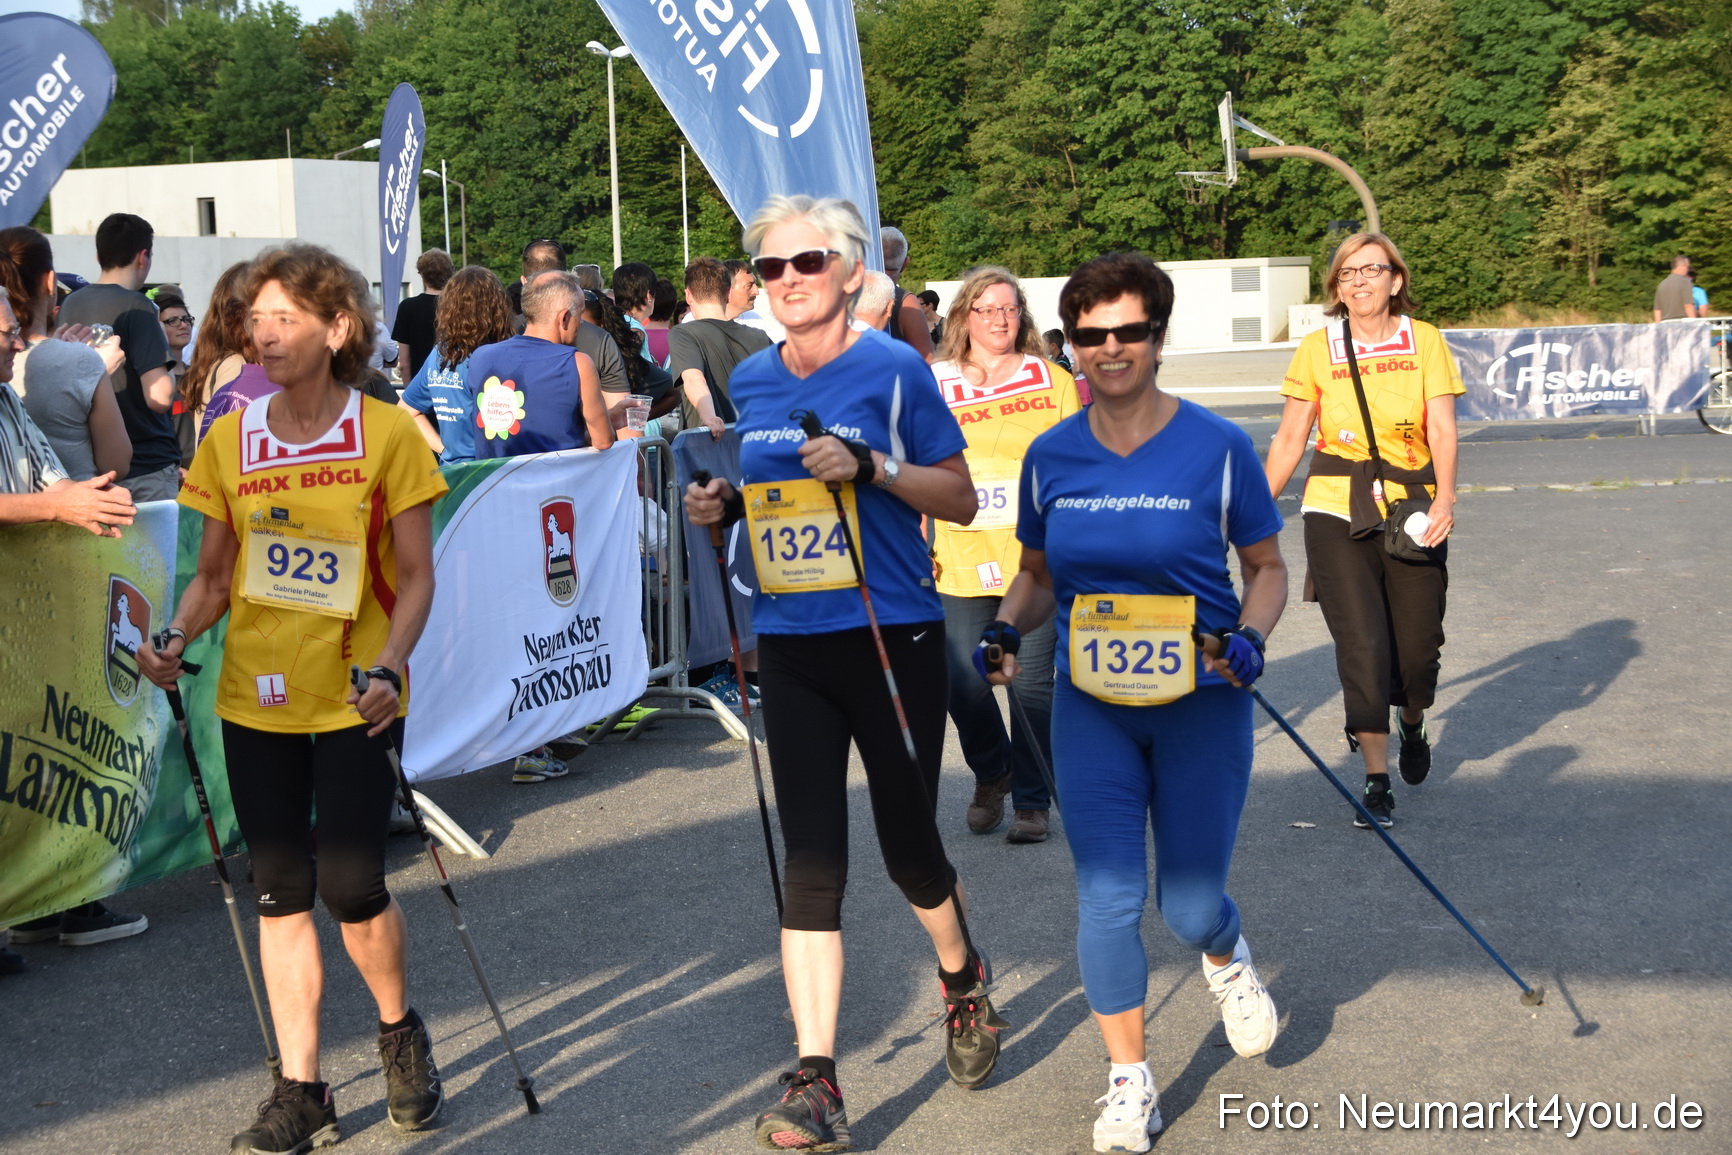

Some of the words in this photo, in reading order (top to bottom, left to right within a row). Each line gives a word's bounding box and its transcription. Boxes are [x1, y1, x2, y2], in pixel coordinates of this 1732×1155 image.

[0, 84, 86, 207] AUTOMOBILE
[1376, 358, 1419, 374] BÖGL
[1515, 363, 1651, 391] Fischer
[1528, 390, 1640, 405] AUTOMOBILE
[954, 408, 993, 426] AX
[999, 396, 1057, 417] BÖGL
[183, 482, 212, 500] egl.de
[237, 475, 291, 497] MAX
[300, 466, 368, 489] BÖGL
[976, 487, 1007, 510] 95
[1055, 494, 1191, 511] energiegeladen
[761, 522, 848, 562] 1324
[267, 543, 340, 585] 923
[273, 584, 303, 595] Gabriele
[303, 588, 329, 599] Platzer
[553, 580, 572, 596] 1628
[1083, 638, 1182, 675] 1325
[113, 671, 132, 698] 1628
[1103, 681, 1135, 689] Gertraud
